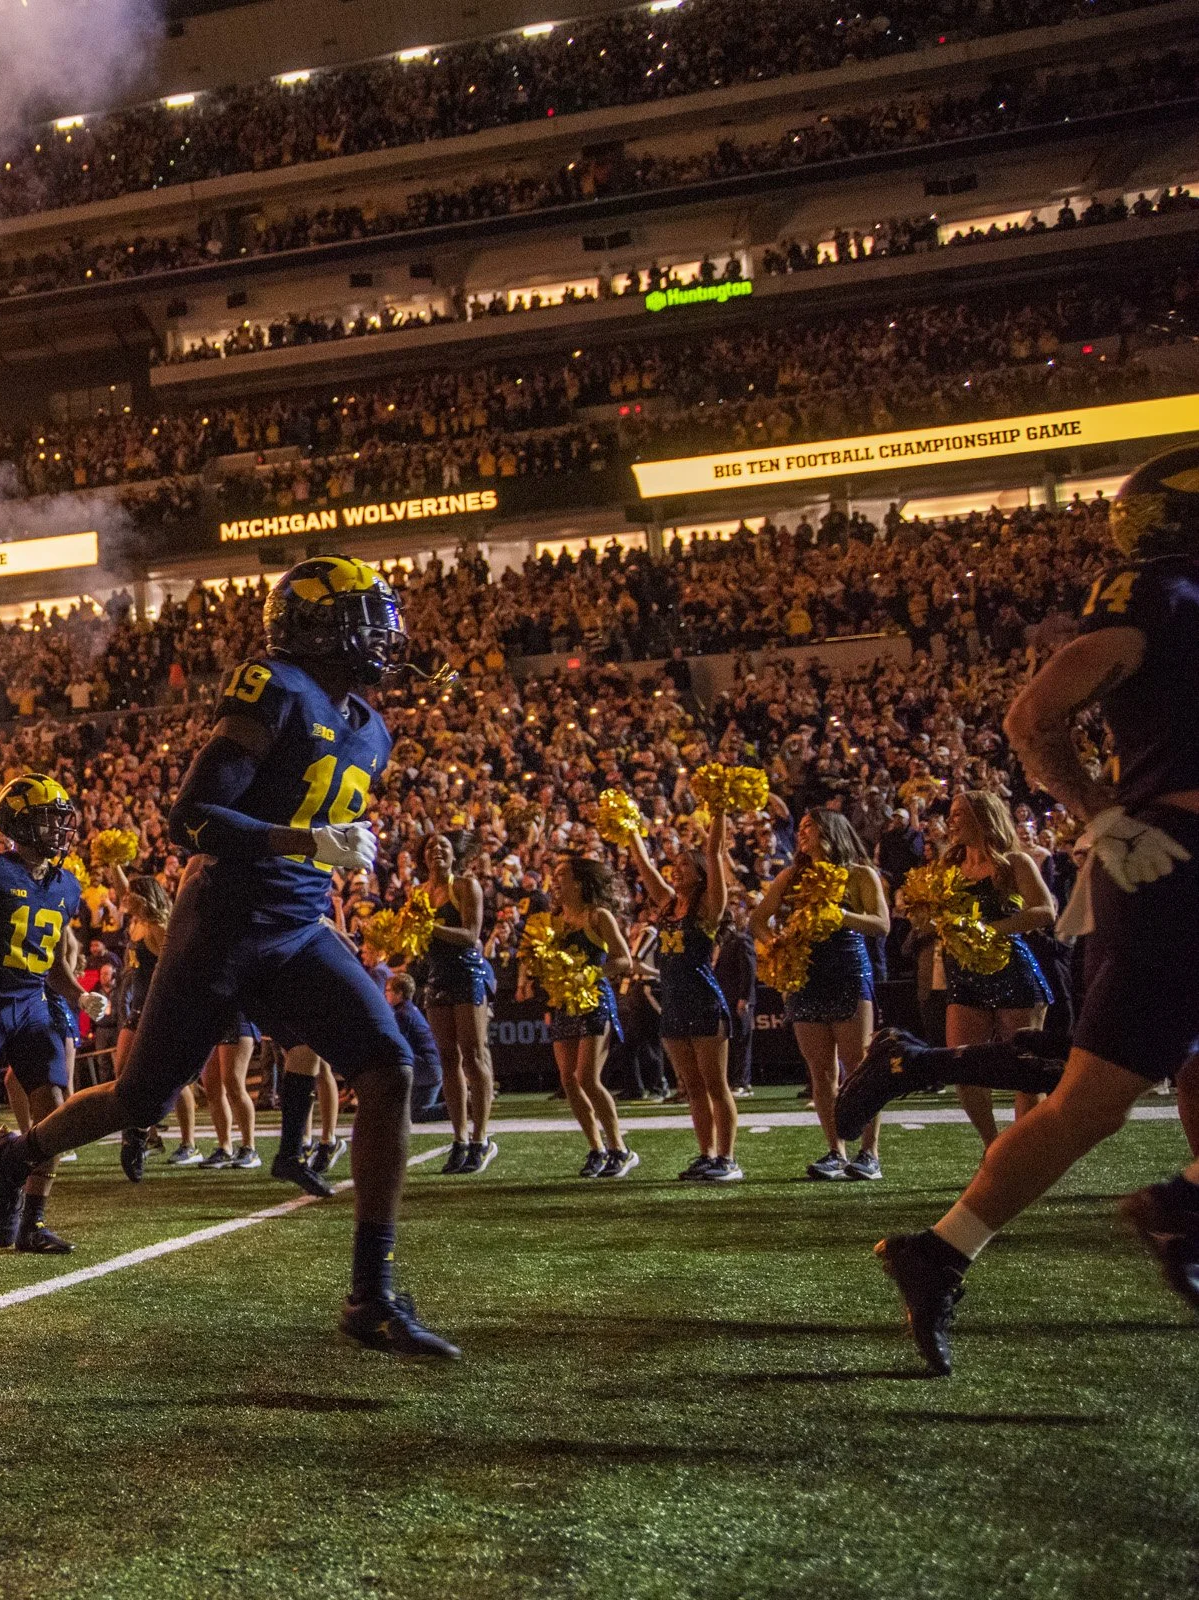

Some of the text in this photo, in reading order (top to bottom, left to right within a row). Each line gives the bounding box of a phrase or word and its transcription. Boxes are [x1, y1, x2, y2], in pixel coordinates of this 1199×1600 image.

[667, 281, 752, 305] Huntington
[713, 421, 1082, 479] BIG TEN FOOTBALL CHAMPIONSHIP GAME
[220, 490, 499, 542] MICHIGAN WOLVERINES
[1082, 572, 1139, 616] 14
[224, 662, 272, 702] 19
[3, 905, 64, 974] 13
[660, 930, 684, 953] M
